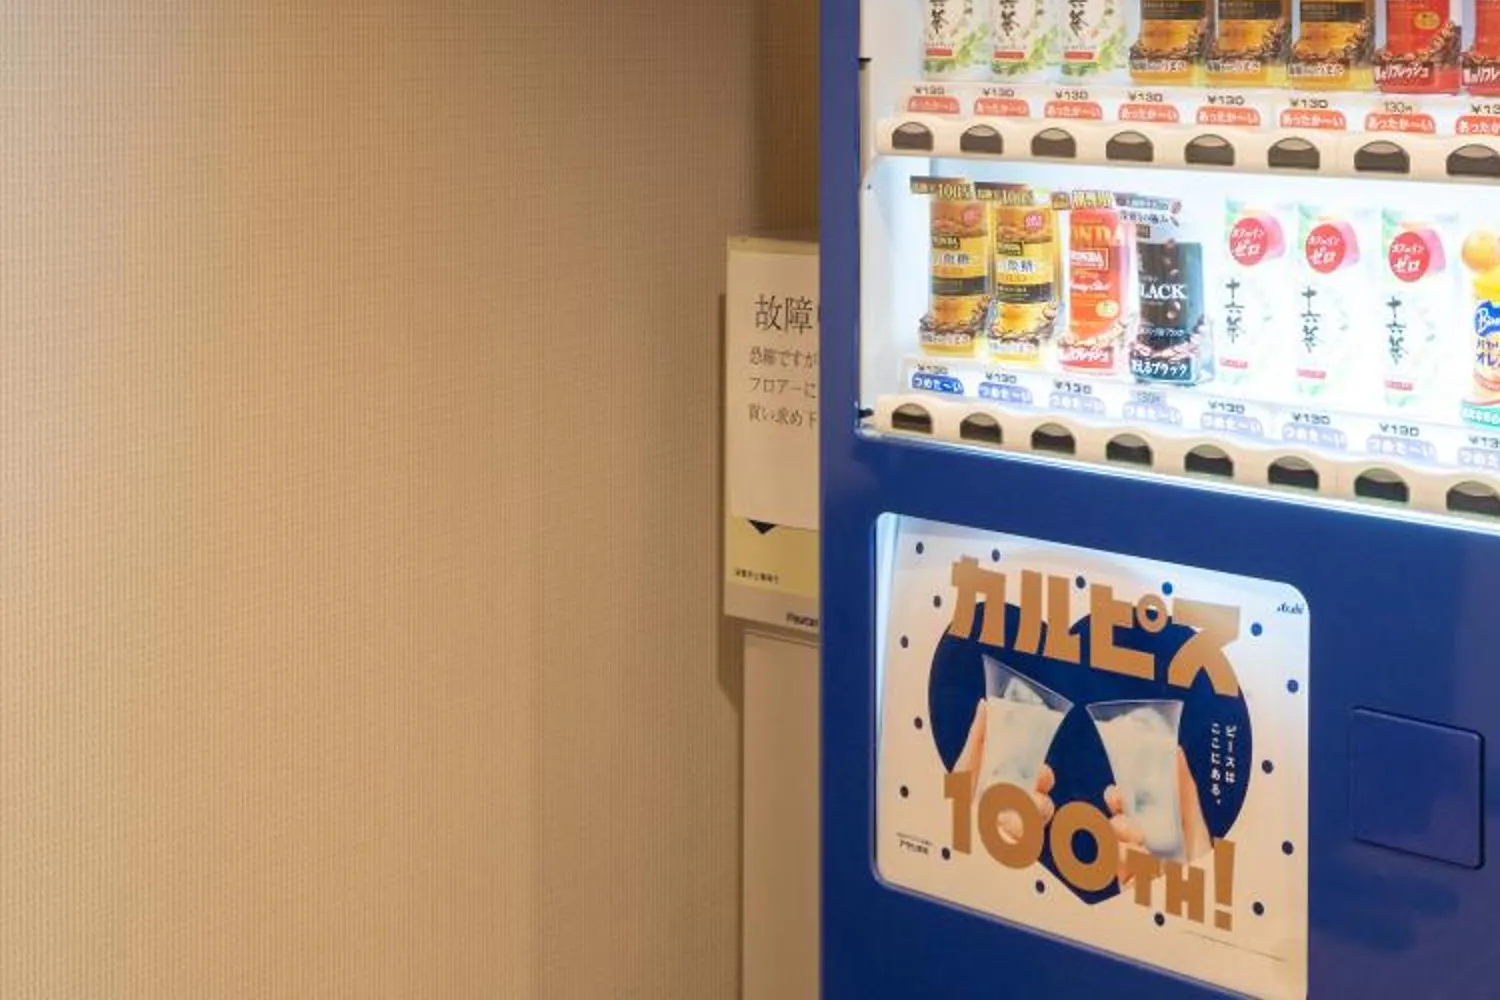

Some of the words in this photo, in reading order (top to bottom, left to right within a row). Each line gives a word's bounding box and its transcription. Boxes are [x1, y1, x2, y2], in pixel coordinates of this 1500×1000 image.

[1290, 97, 1328, 108] ¥130
[754, 293, 820, 334] 故障
[1139, 283, 1189, 300] LACK
[1224, 278, 1245, 343] 十六茶
[1300, 286, 1321, 353] 十六茶
[1386, 296, 1409, 365] 十六茶
[749, 377, 817, 399] フロアーに
[950, 555, 1240, 697] カルピス
